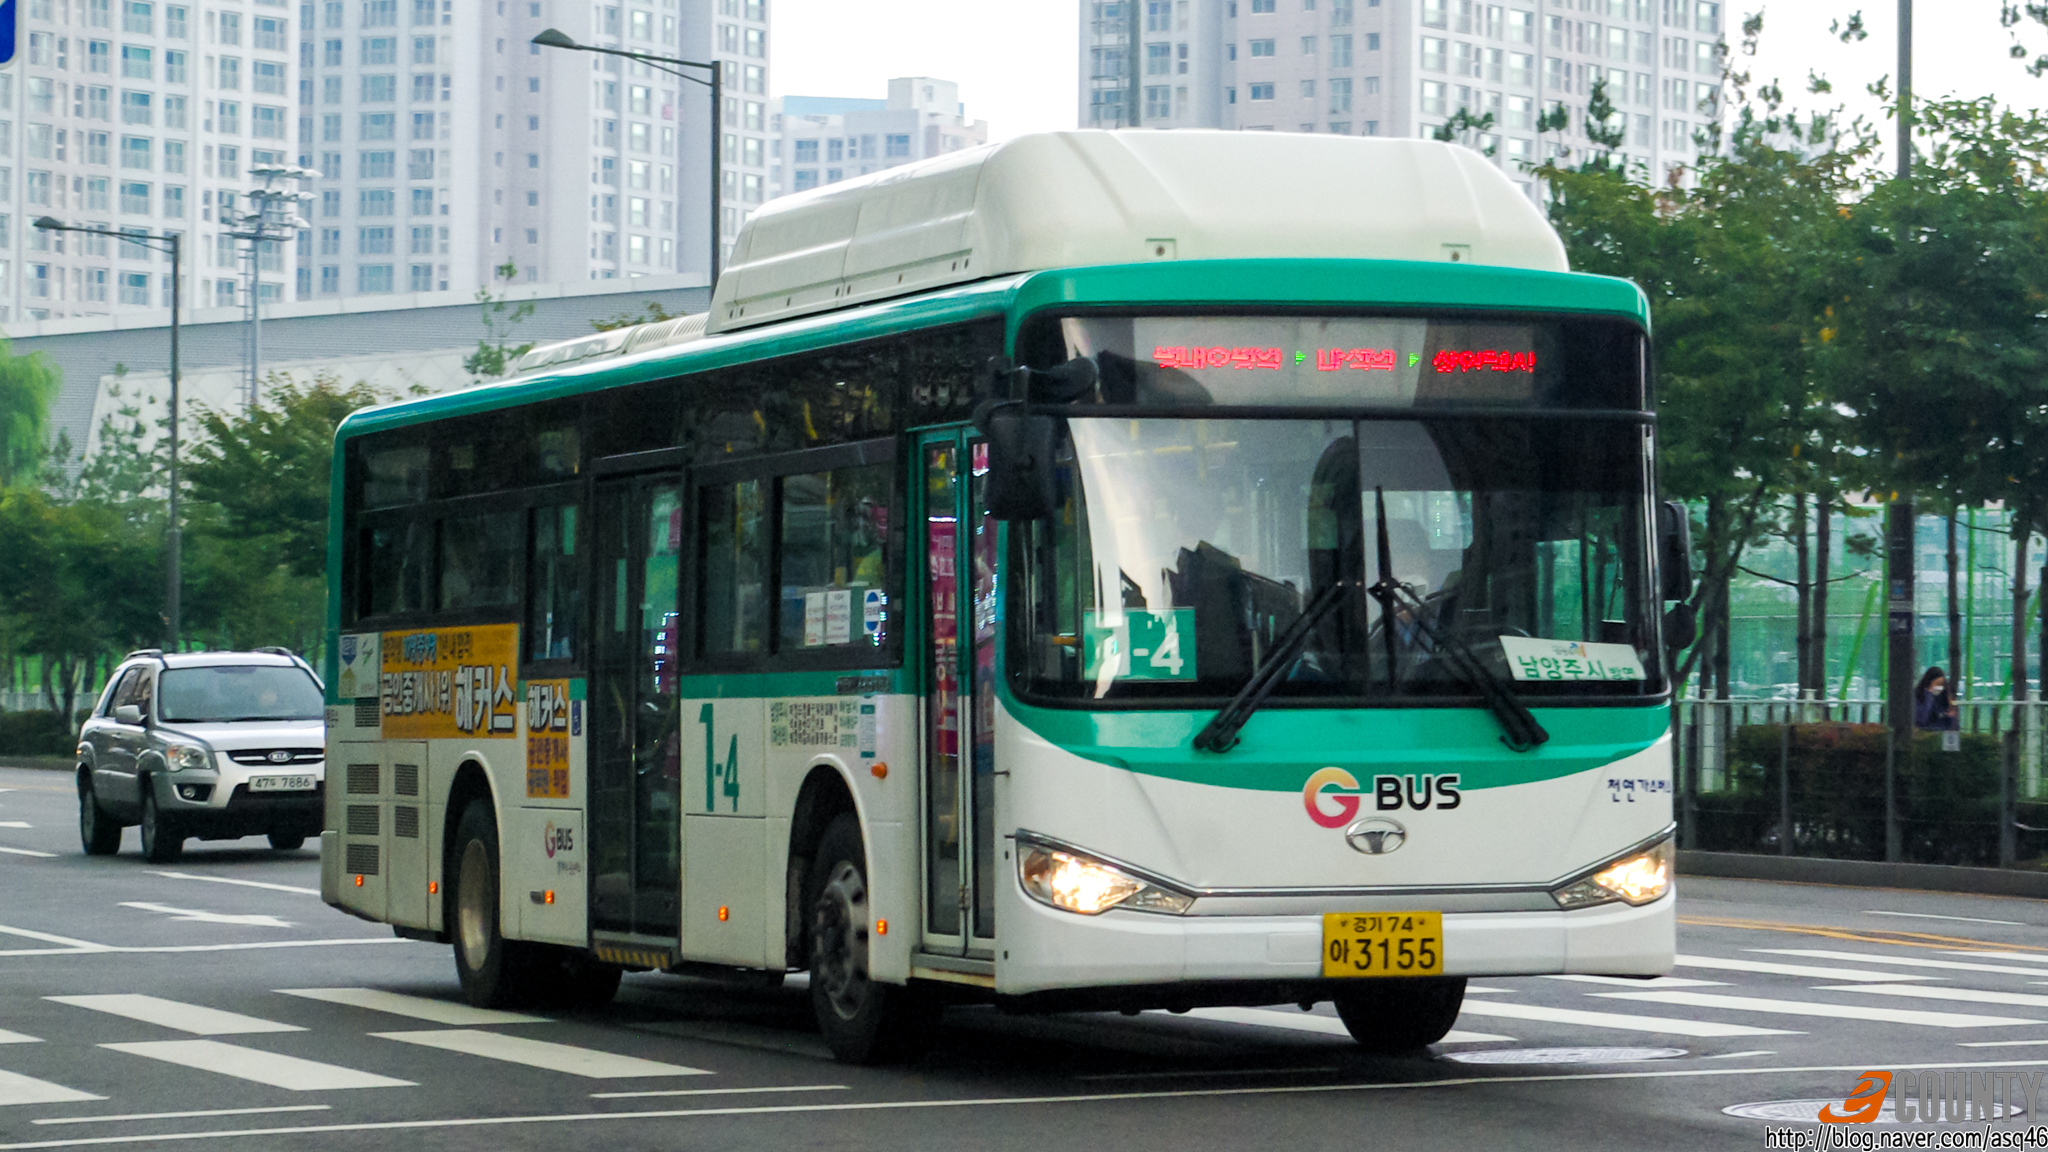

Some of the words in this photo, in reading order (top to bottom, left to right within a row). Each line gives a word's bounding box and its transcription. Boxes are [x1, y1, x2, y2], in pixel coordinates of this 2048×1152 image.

[1518, 656, 1607, 680] 남양주시
[455, 664, 514, 734] 해커스
[528, 683, 567, 730] 해커스
[698, 702, 740, 813] 1-4
[1375, 776, 1461, 811] BUS
[1353, 916, 1382, 933] 경기
[1387, 916, 1414, 933] 74
[1329, 938, 1351, 964] 아
[1354, 937, 1437, 970] 3155
